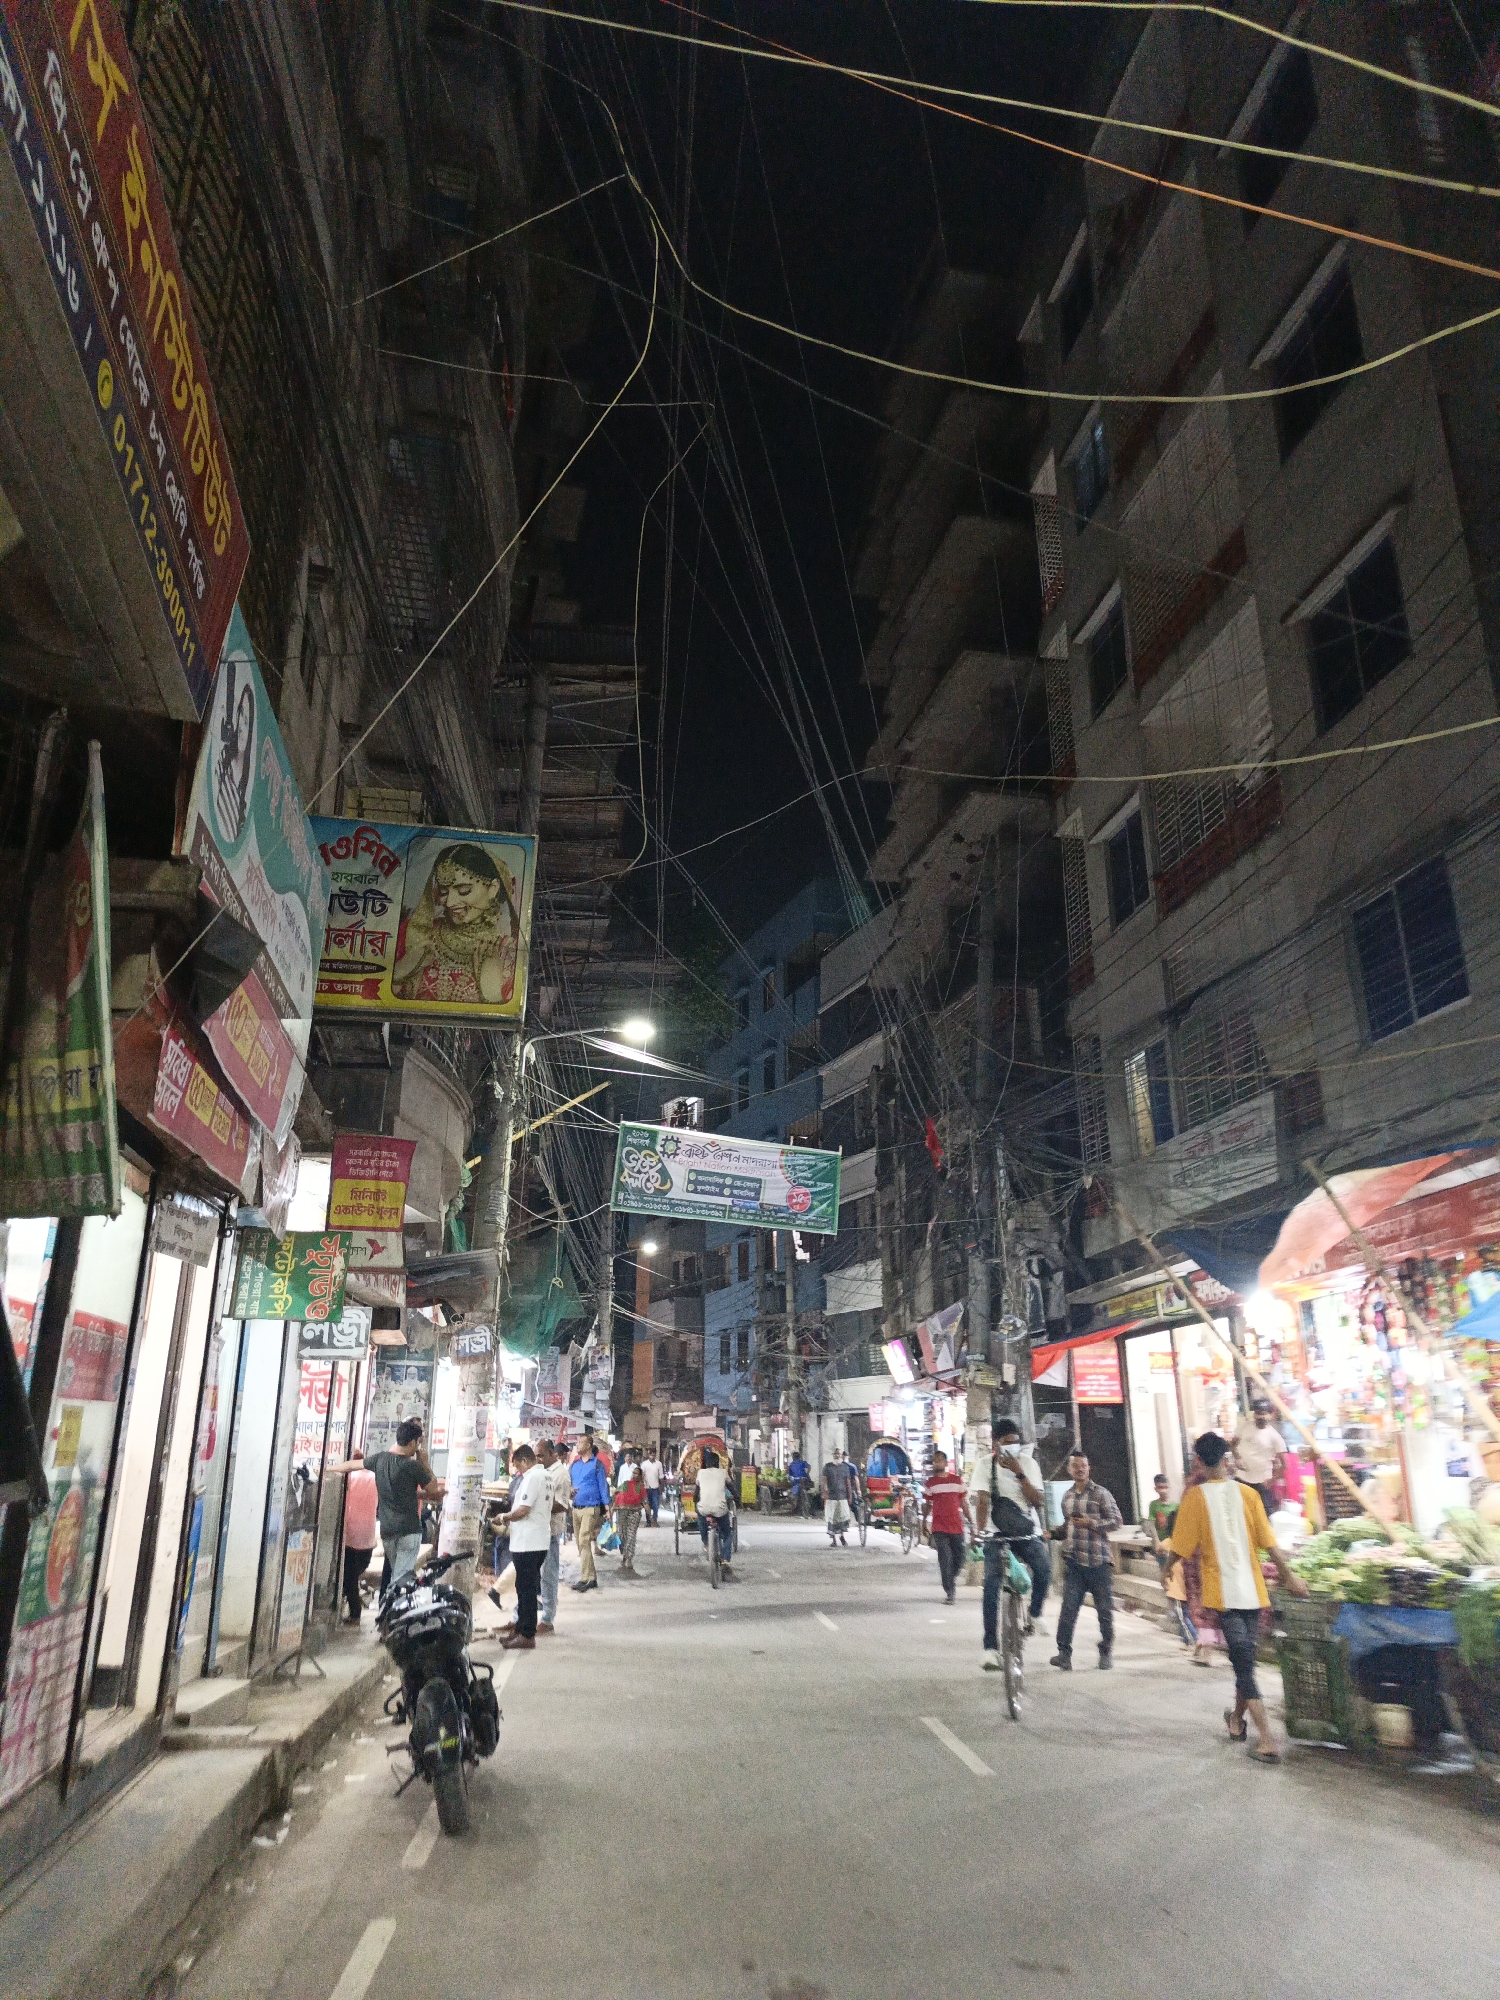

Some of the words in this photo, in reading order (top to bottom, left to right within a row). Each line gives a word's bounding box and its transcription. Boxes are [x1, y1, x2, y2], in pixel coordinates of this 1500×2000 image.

[119, 123, 233, 557] ইনস্টিটিউট
[119, 313, 150, 408] থেকে
[149, 409, 167, 470] ৮ম
[113, 413, 196, 668] 01712-390011
[265, 1232, 299, 1318] ফটোকপি
[333, 1202, 376, 1217] একাউন্ট
[376, 1206, 400, 1219] খুলুন
